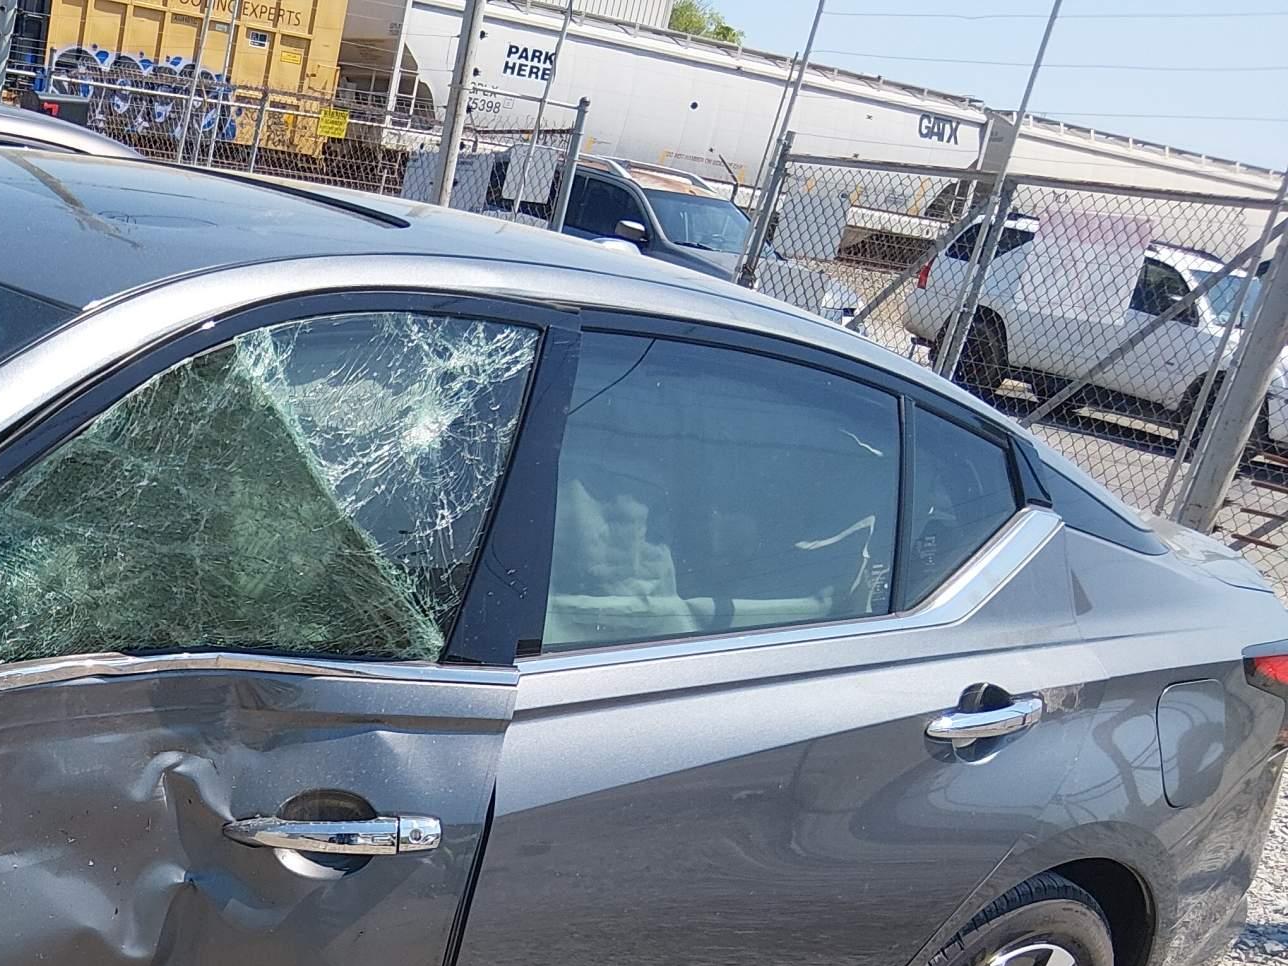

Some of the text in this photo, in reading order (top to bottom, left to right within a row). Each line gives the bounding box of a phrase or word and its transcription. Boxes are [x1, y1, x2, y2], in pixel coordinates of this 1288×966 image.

[243, 1, 302, 27] EXPERTS
[506, 44, 557, 66] PARK
[502, 60, 553, 82] HERE
[919, 114, 960, 145] GATX
